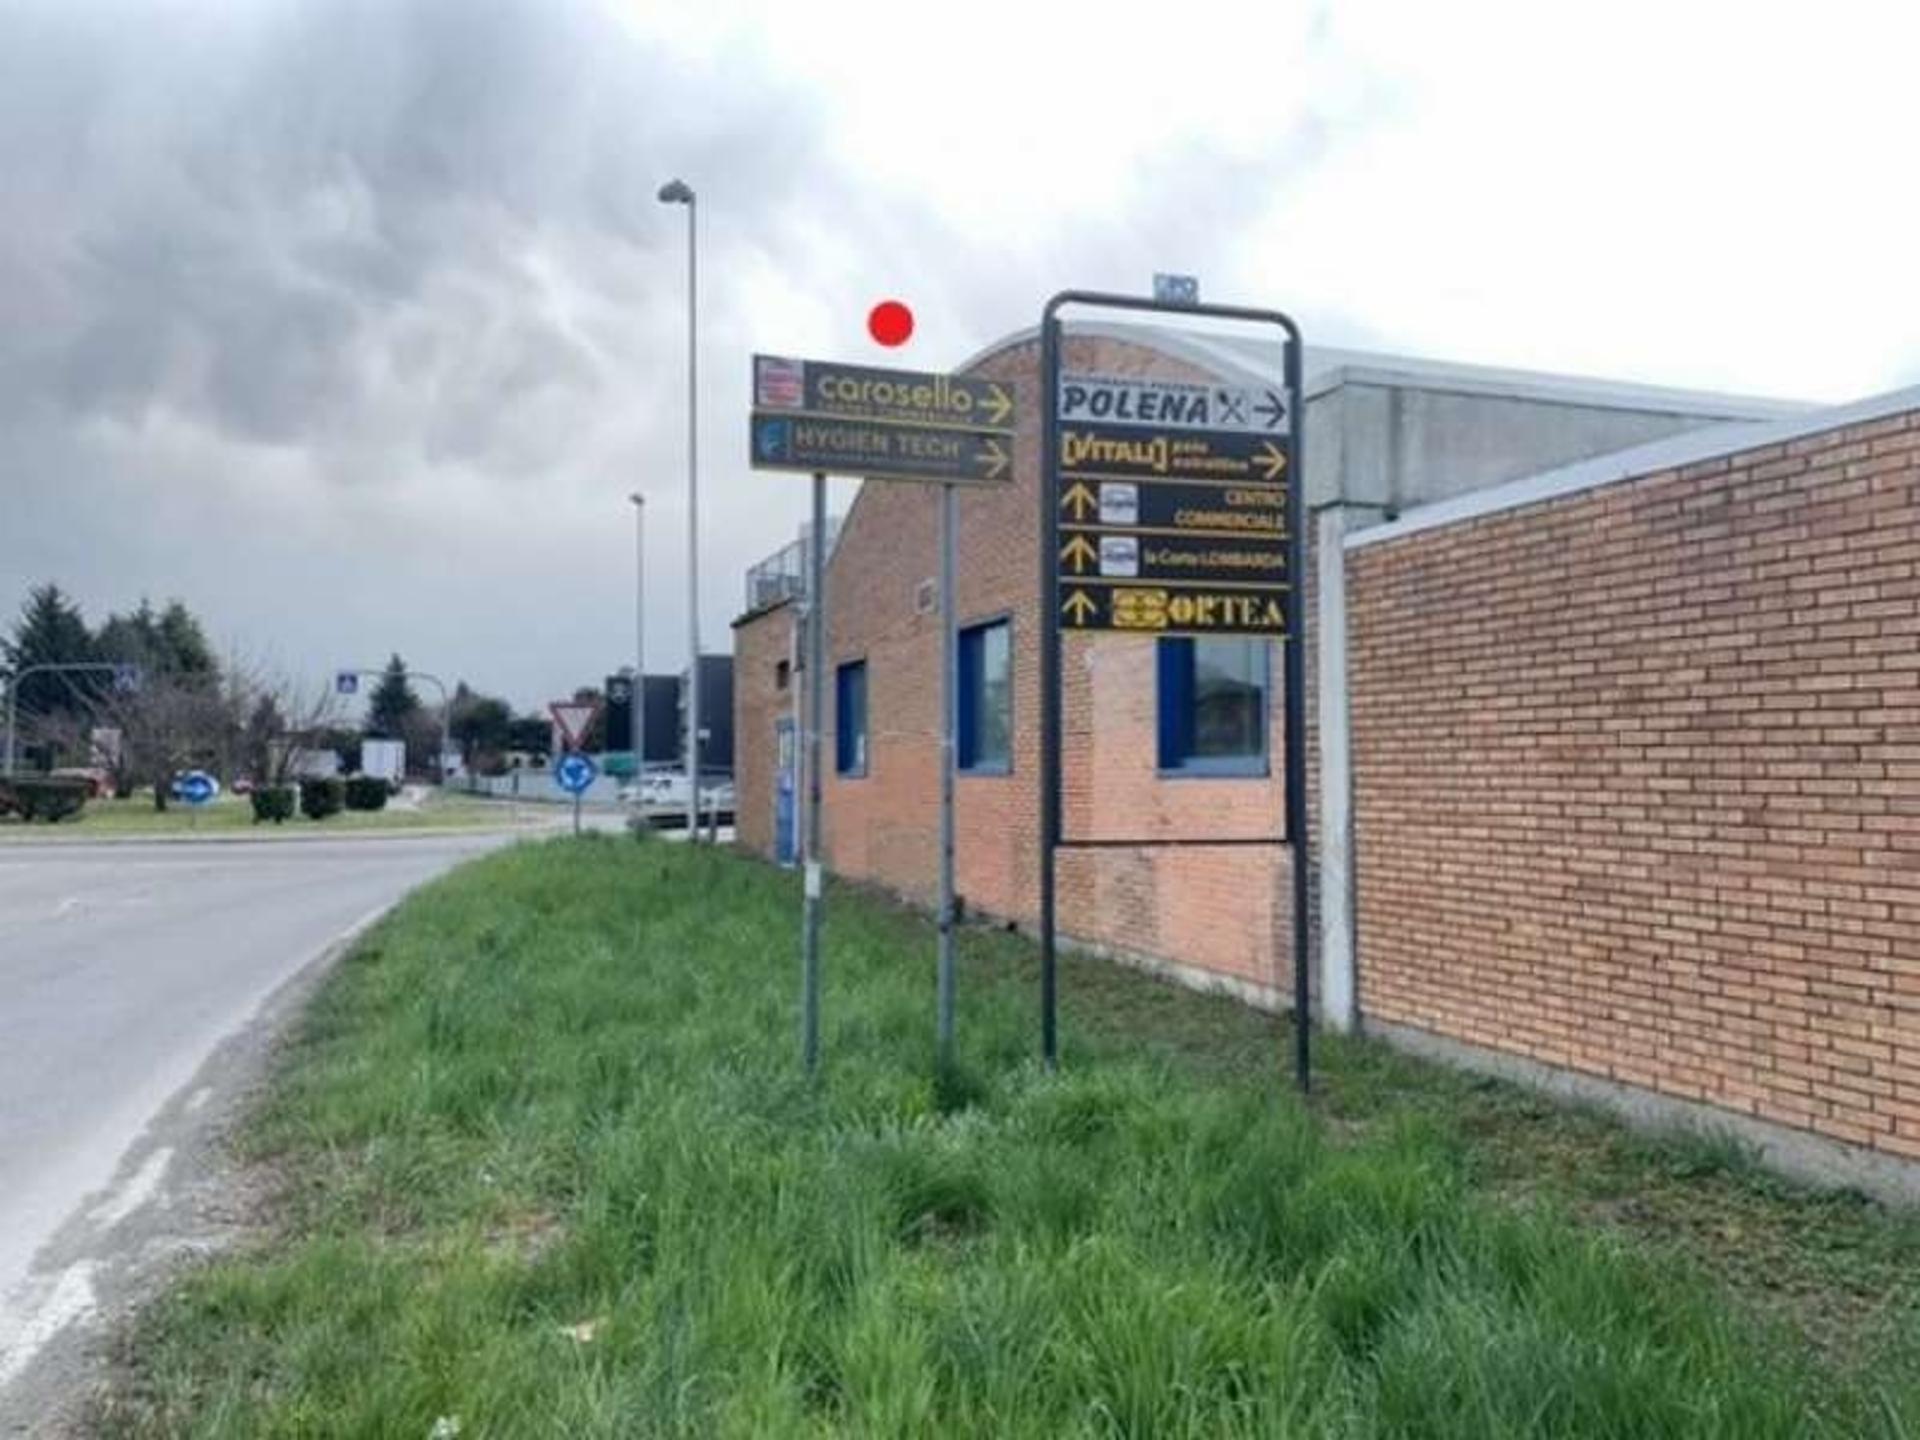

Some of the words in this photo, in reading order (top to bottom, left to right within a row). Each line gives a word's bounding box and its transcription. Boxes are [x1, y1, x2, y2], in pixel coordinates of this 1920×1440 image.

[818, 374, 972, 412] carosello
[1063, 386, 1210, 424] POLENA
[899, 435, 959, 458] TECH
[1225, 489, 1285, 507] CENTRO
